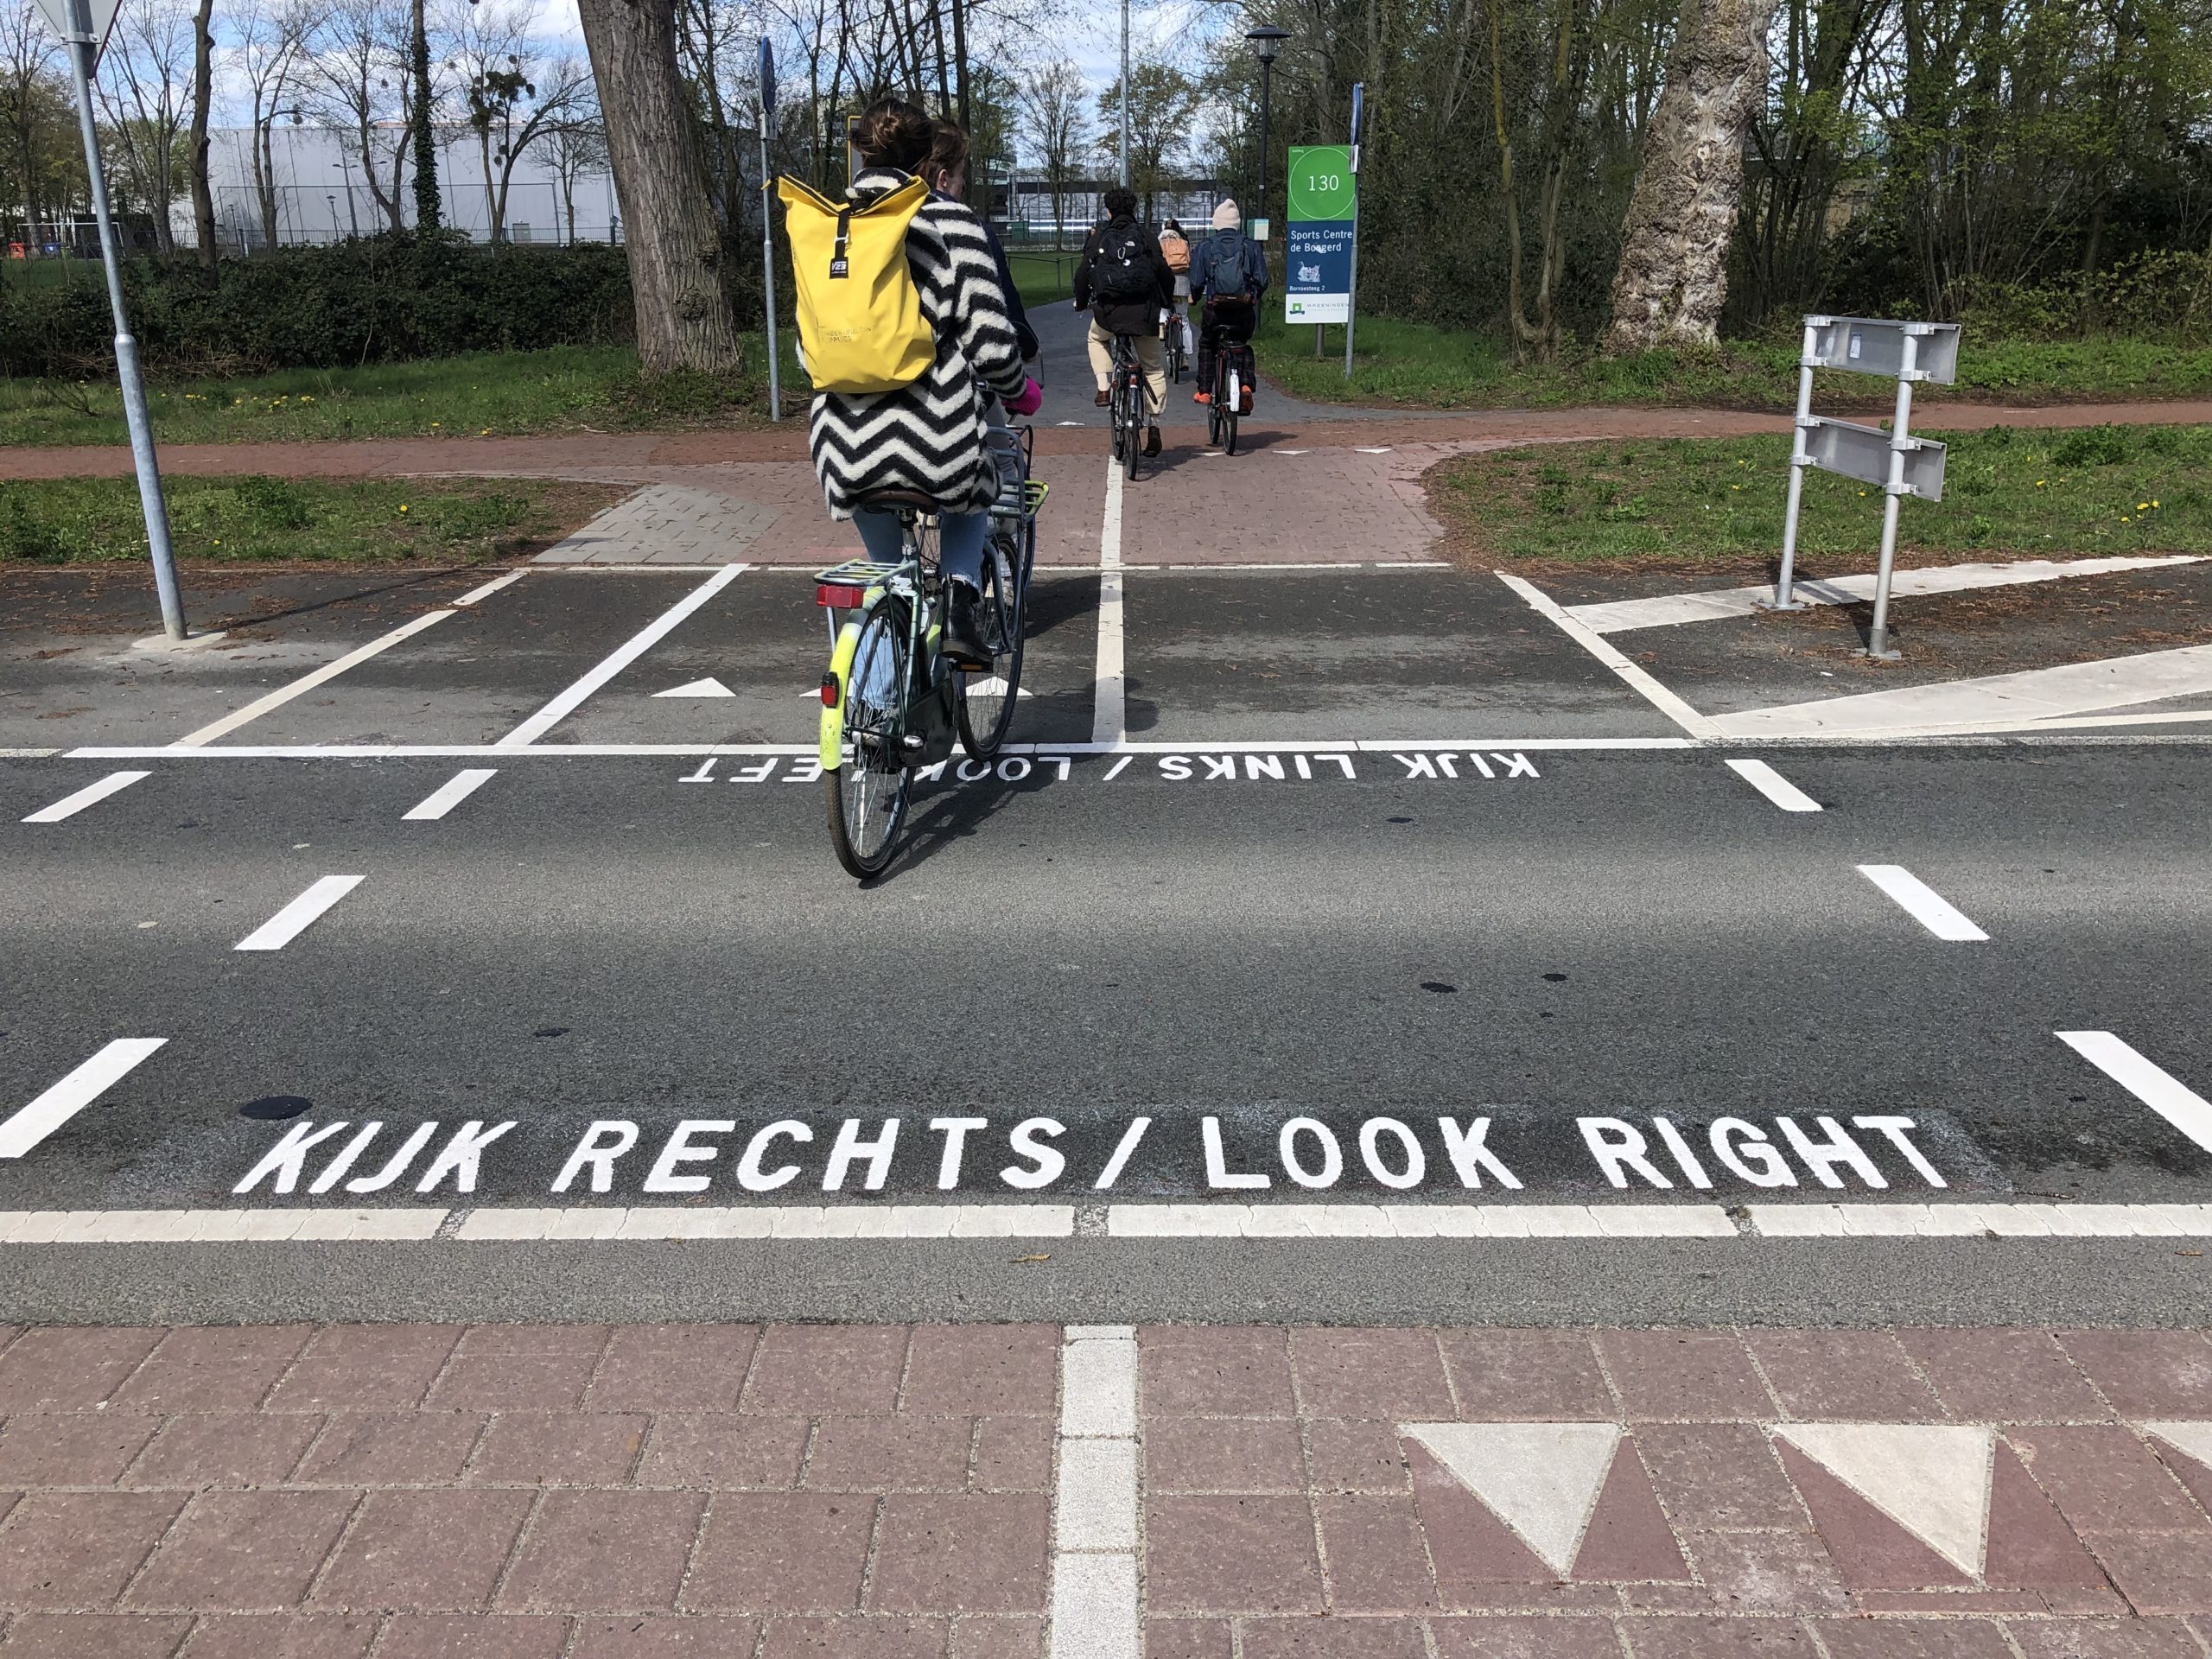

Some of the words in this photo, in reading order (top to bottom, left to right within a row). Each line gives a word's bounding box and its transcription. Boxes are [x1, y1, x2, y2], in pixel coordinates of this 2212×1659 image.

[1308, 175, 1339, 191] 130
[1290, 230, 1320, 241] Sports
[1323, 229, 1353, 239] Centre
[1290, 243, 1301, 252] de
[913, 756, 1071, 782] LOOK
[1102, 756, 1134, 781] /
[1158, 754, 1357, 780] LINKS
[1391, 753, 1541, 779] KIJK
[232, 1121, 519, 1194] KIJK
[550, 1116, 1066, 1192] RECHTS
[1093, 1116, 1153, 1189] /
[1202, 1116, 1524, 1190] LOOK
[1575, 1116, 1948, 1189] RIGHT
